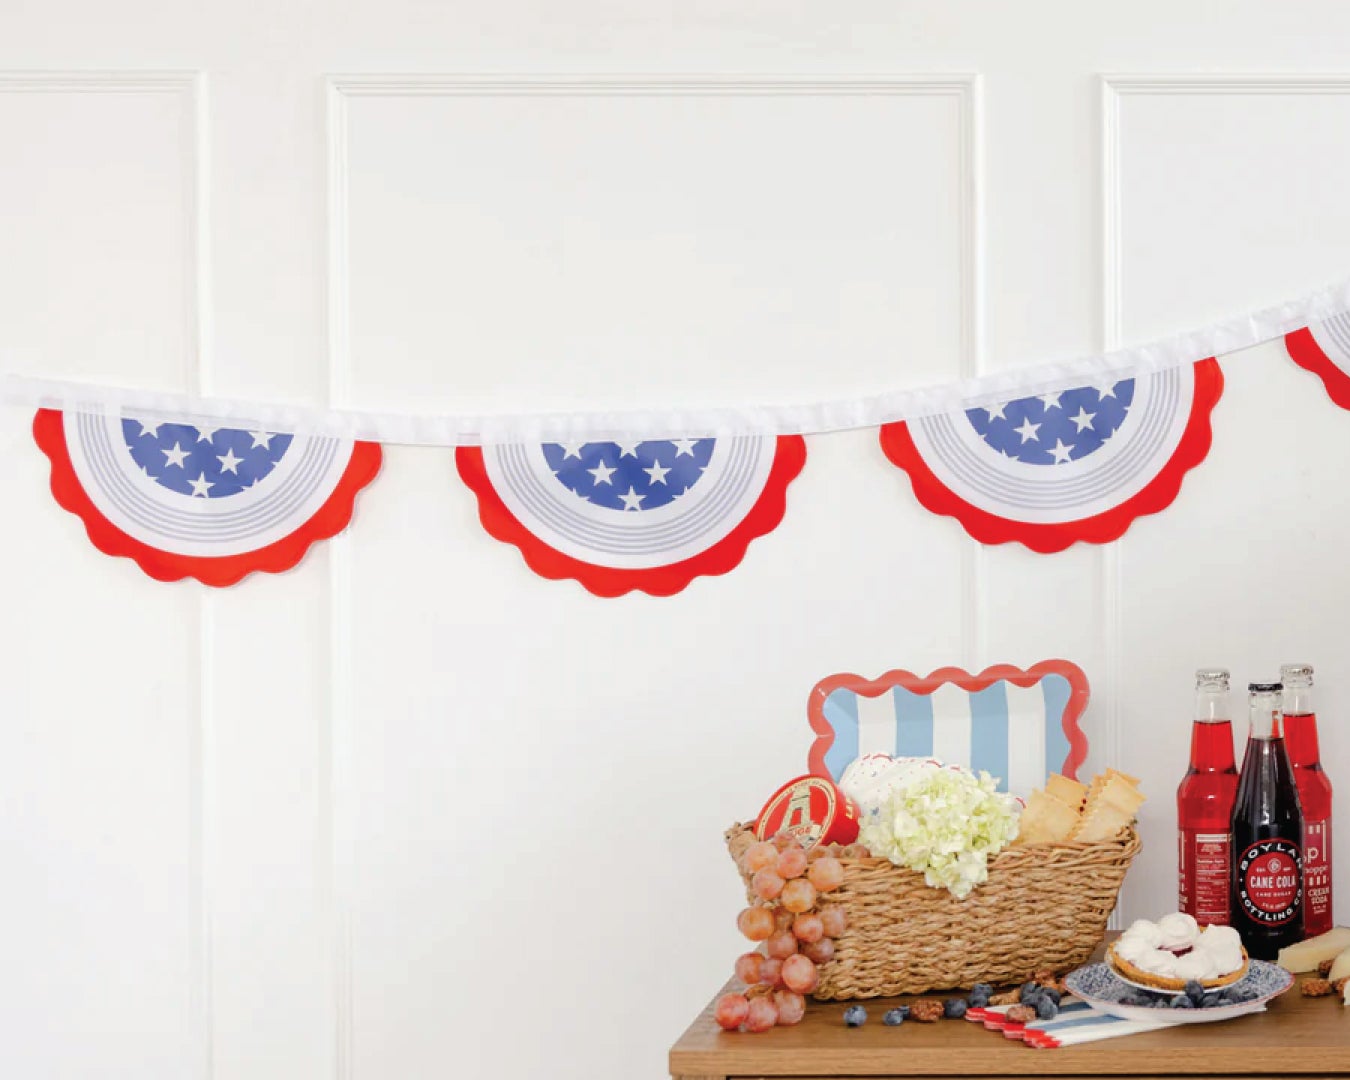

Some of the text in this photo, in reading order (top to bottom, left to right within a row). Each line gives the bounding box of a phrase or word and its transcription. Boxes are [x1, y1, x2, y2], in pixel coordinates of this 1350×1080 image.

[1250, 875, 1296, 889] CANE COLA
[1241, 890, 1293, 921] BOTTLING
